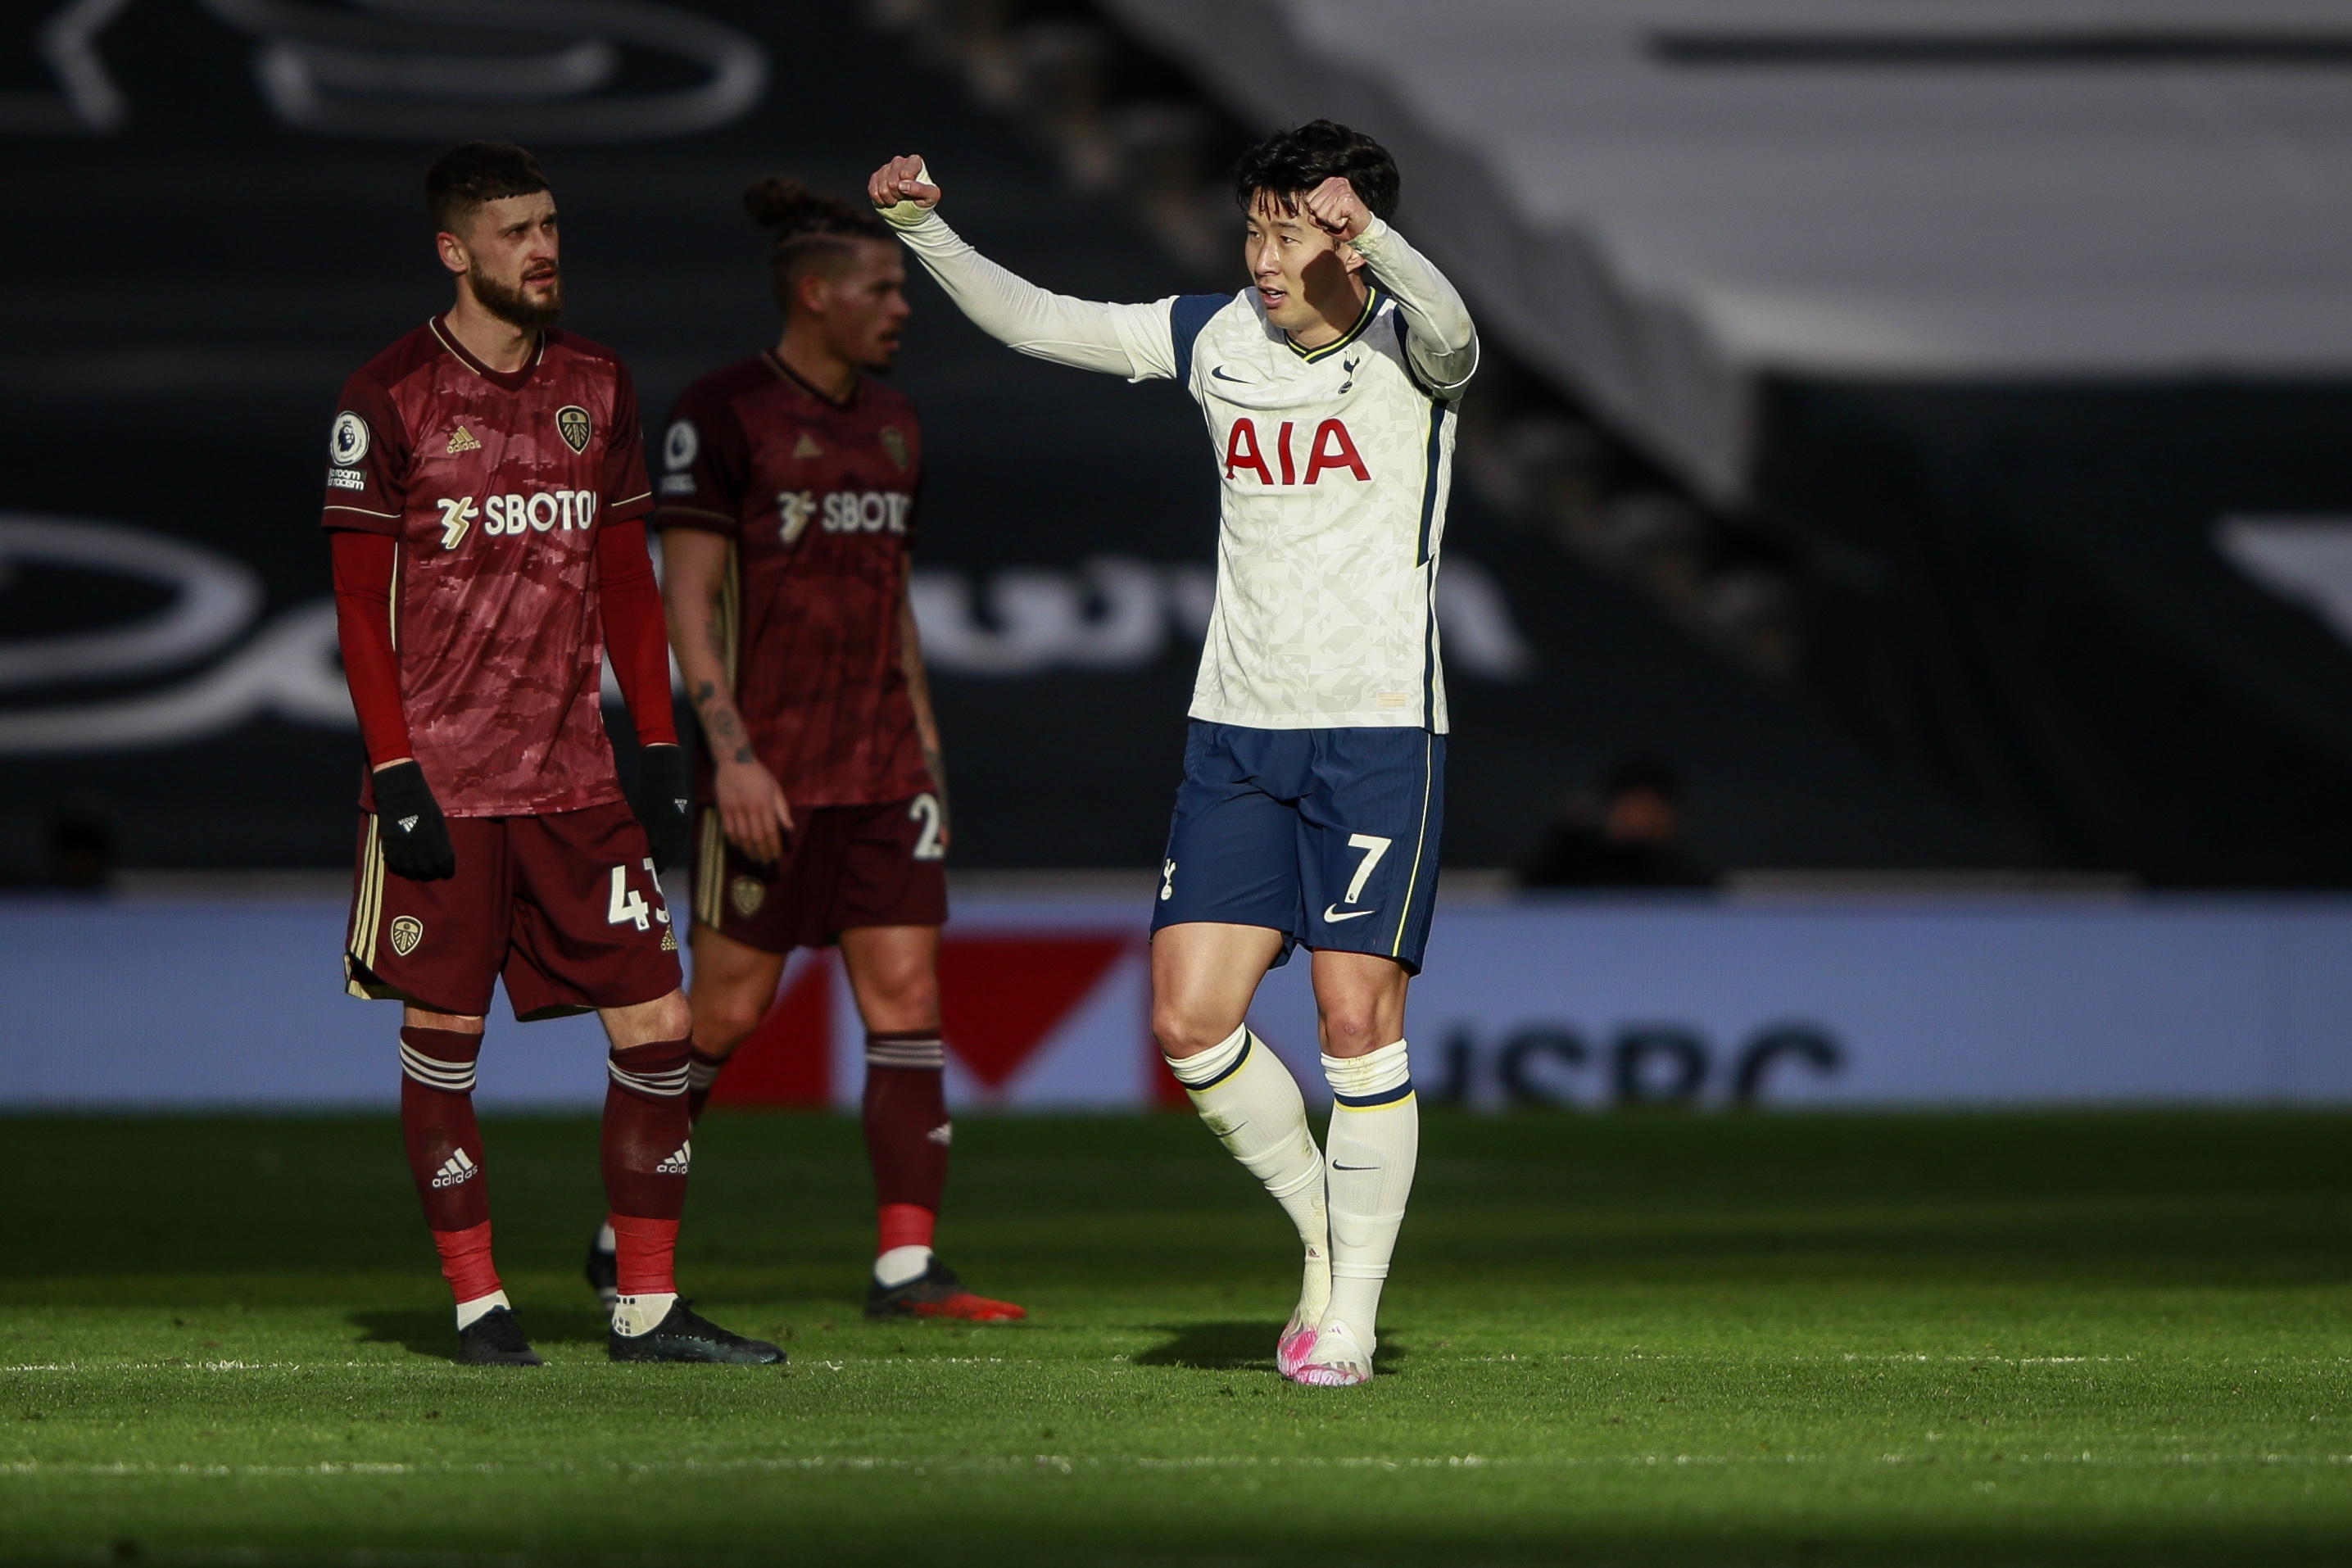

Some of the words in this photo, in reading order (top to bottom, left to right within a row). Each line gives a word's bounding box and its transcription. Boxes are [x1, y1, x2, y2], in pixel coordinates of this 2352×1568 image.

[446, 439, 482, 454] adidas
[1226, 417, 1372, 486] AIA
[333, 478, 365, 491] racism
[336, 469, 360, 480] room
[484, 489, 597, 536] SBOTO
[909, 792, 945, 860] 2
[1348, 833, 1392, 904] 7
[432, 1164, 478, 1188] adidas
[656, 1162, 689, 1175] adid
